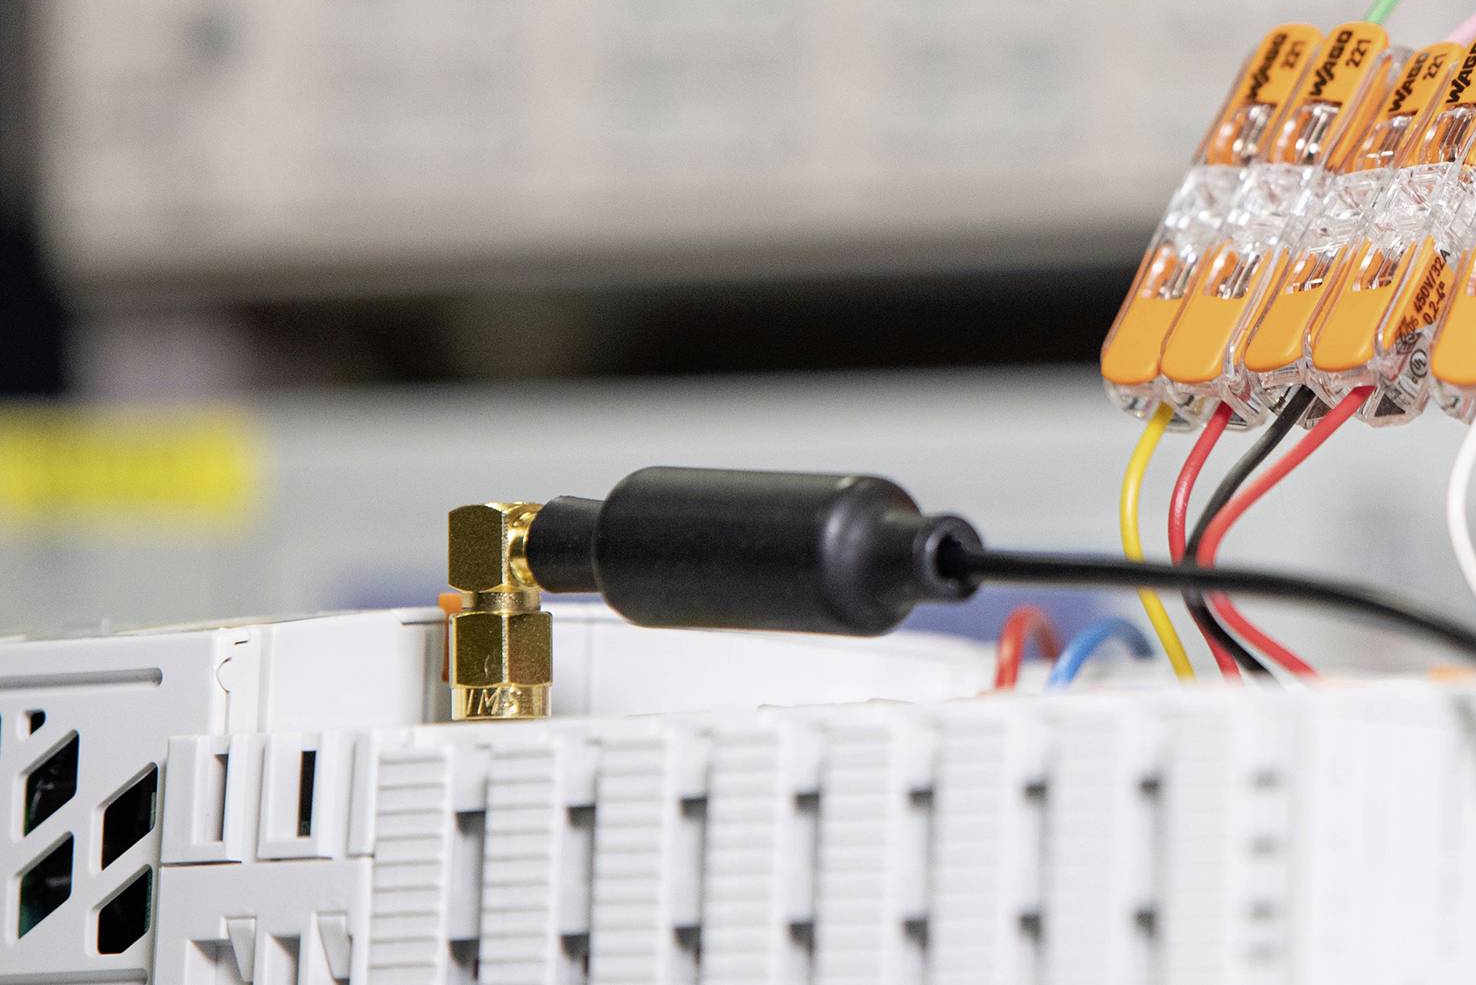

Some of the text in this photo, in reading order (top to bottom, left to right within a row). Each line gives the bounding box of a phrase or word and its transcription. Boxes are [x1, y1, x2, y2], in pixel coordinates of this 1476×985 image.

[1247, 33, 1287, 103] WAGO
[1309, 30, 1353, 96] WAGO
[1346, 38, 1371, 68] 221
[1388, 52, 1430, 113] WAGO
[1422, 52, 1447, 81] 221
